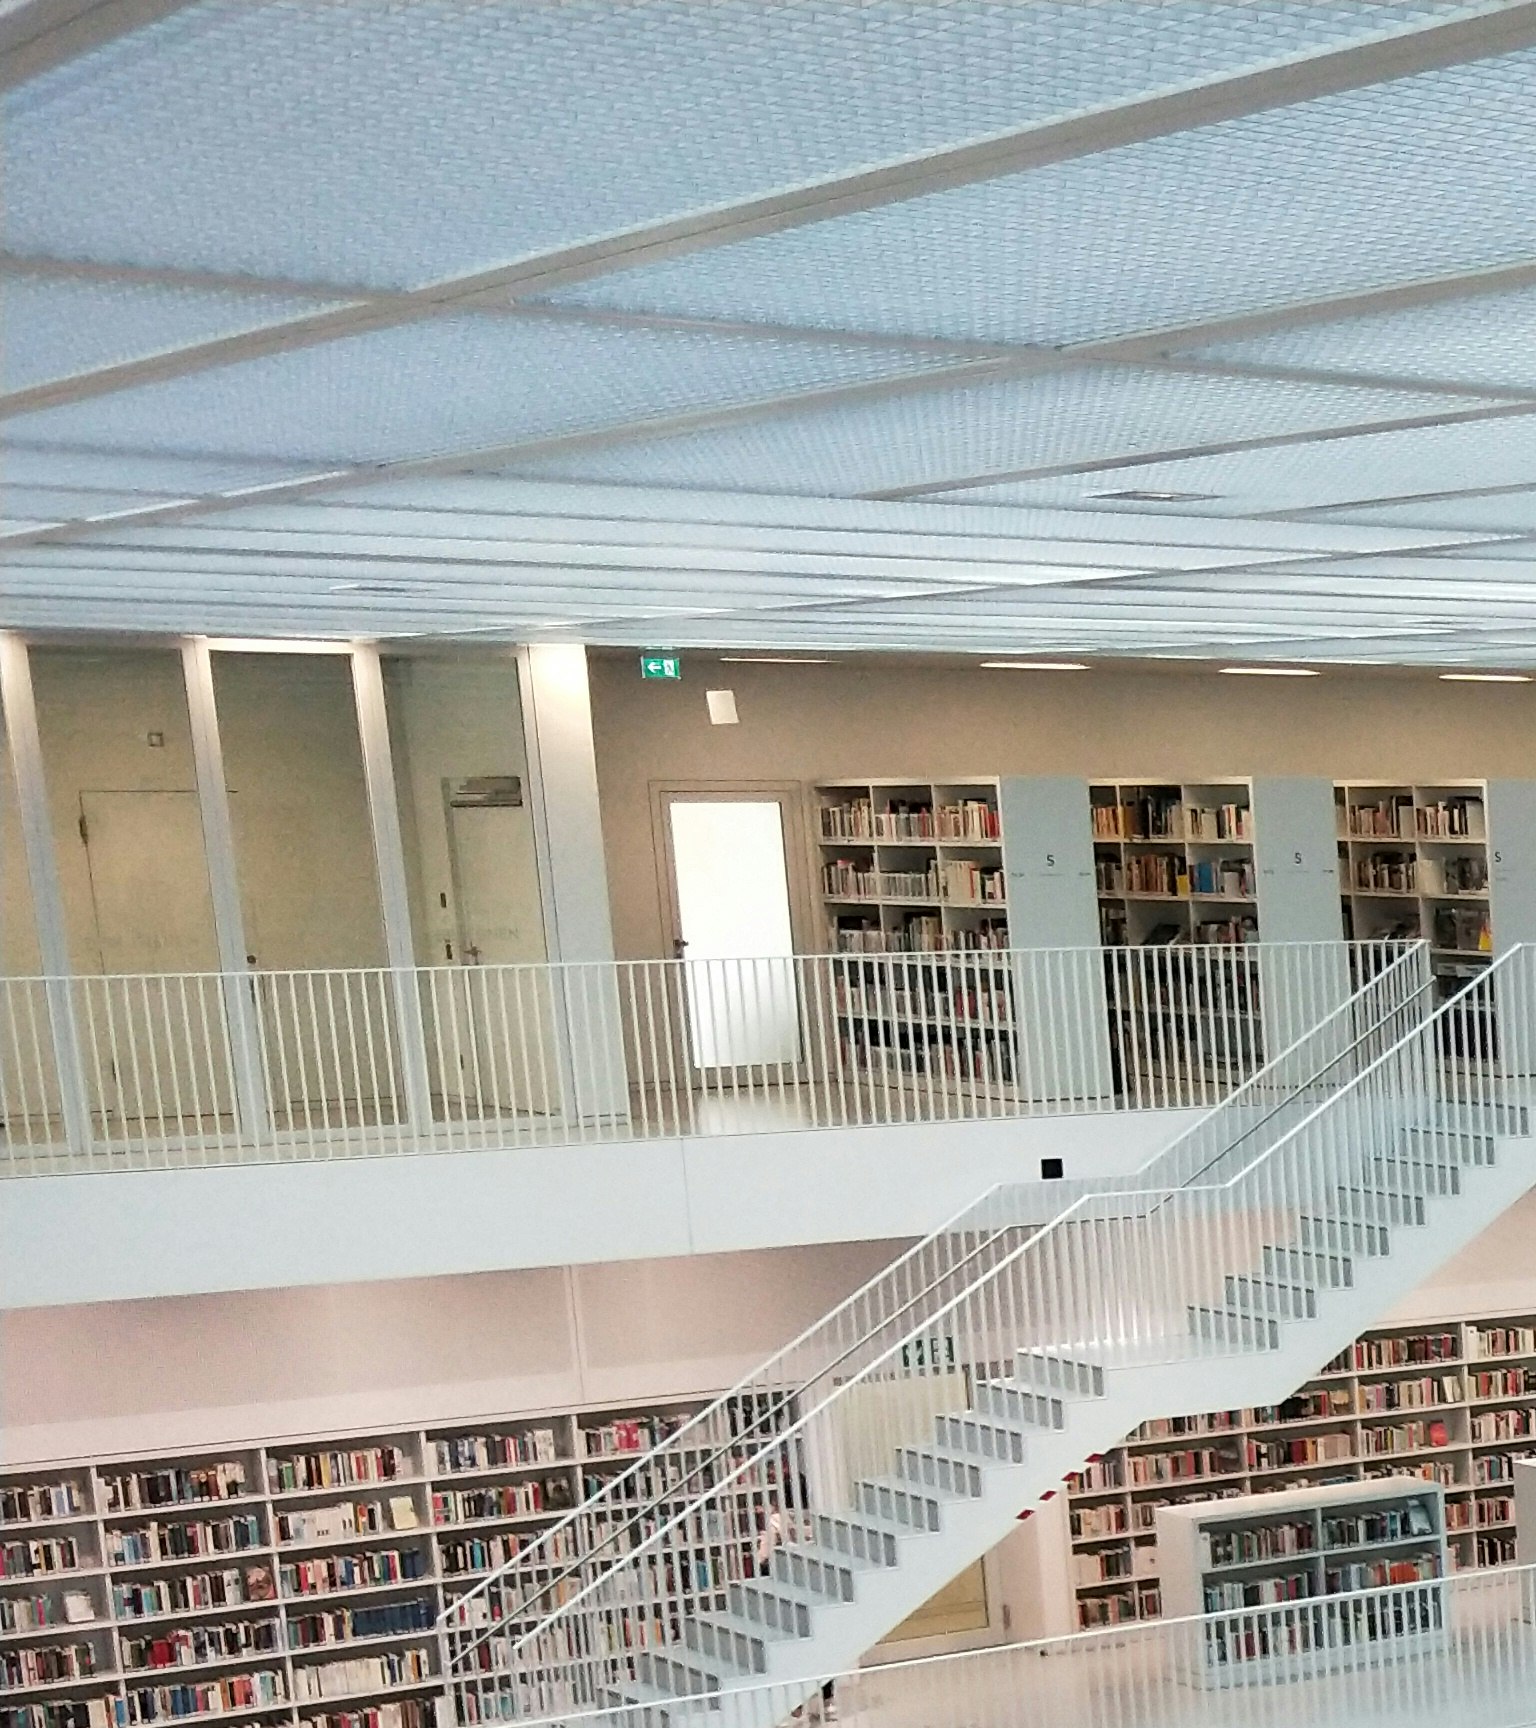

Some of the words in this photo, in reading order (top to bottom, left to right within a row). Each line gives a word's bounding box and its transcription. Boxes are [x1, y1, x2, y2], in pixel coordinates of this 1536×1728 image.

[1046, 855, 1054, 867] S
[1294, 853, 1301, 865] S
[1494, 852, 1501, 863] S
